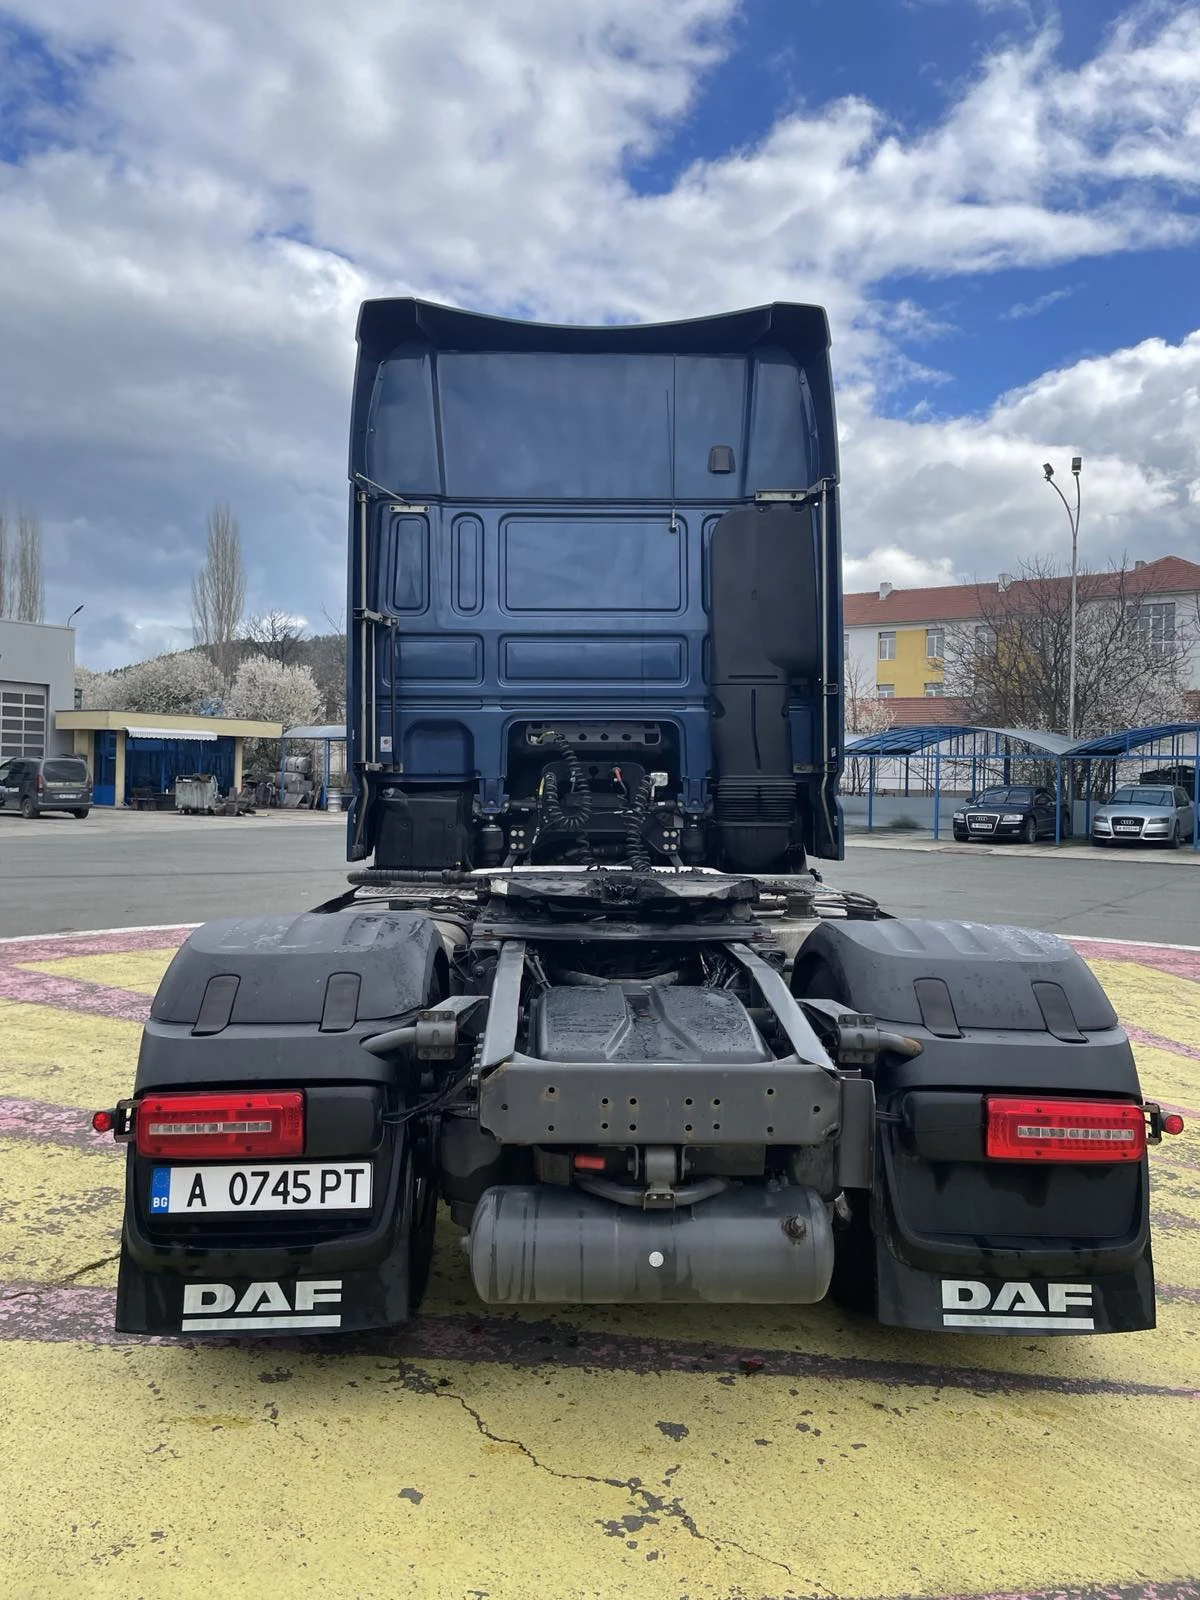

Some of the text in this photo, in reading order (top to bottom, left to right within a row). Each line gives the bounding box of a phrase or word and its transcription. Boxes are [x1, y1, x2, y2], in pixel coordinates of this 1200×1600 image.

[153, 1197, 168, 1208] BG
[186, 1172, 207, 1207] A
[183, 1280, 342, 1314] DAF
[941, 1279, 1093, 1312] DAF
